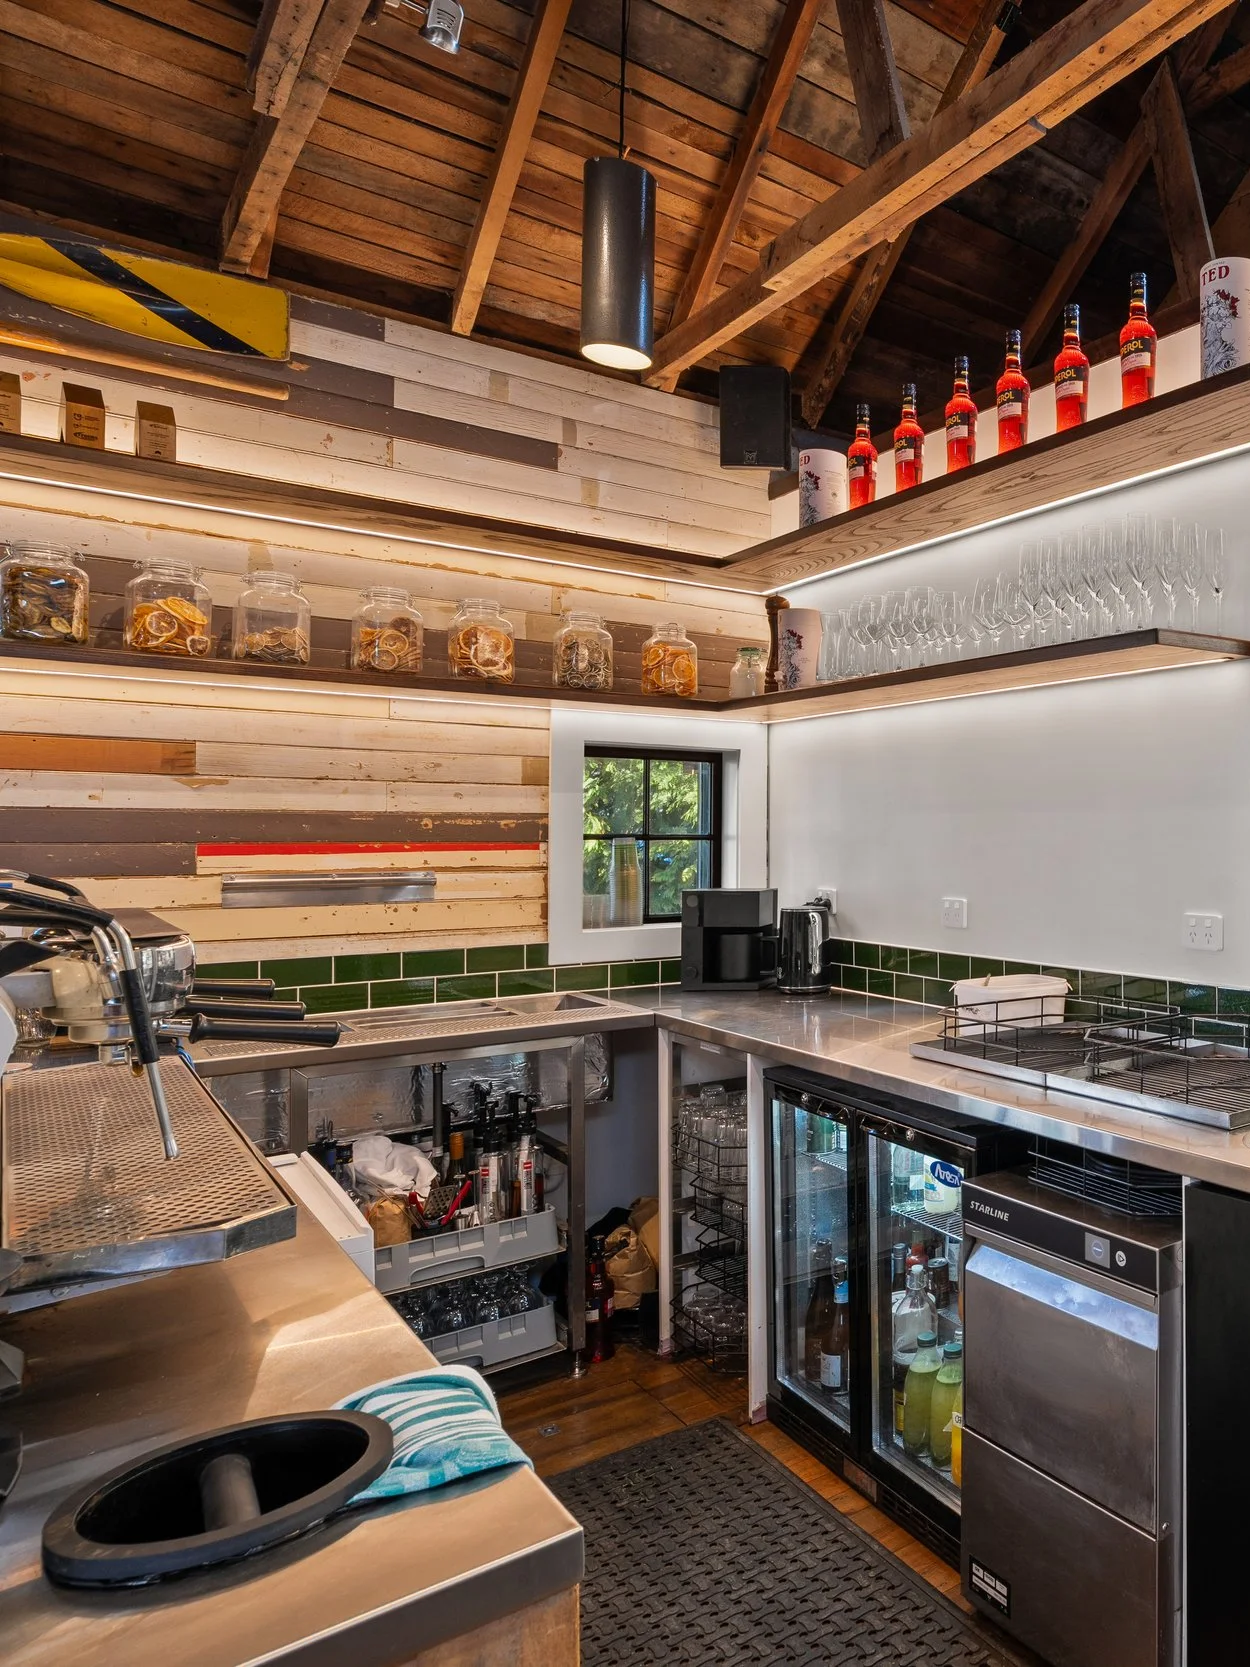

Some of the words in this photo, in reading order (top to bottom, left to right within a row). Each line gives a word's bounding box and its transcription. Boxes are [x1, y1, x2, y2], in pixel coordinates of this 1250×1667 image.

[1201, 265, 1230, 286] TED
[1120, 340, 1144, 355] PEROL
[799, 455, 811, 466] ED
[970, 1201, 1009, 1221] STARLINE
